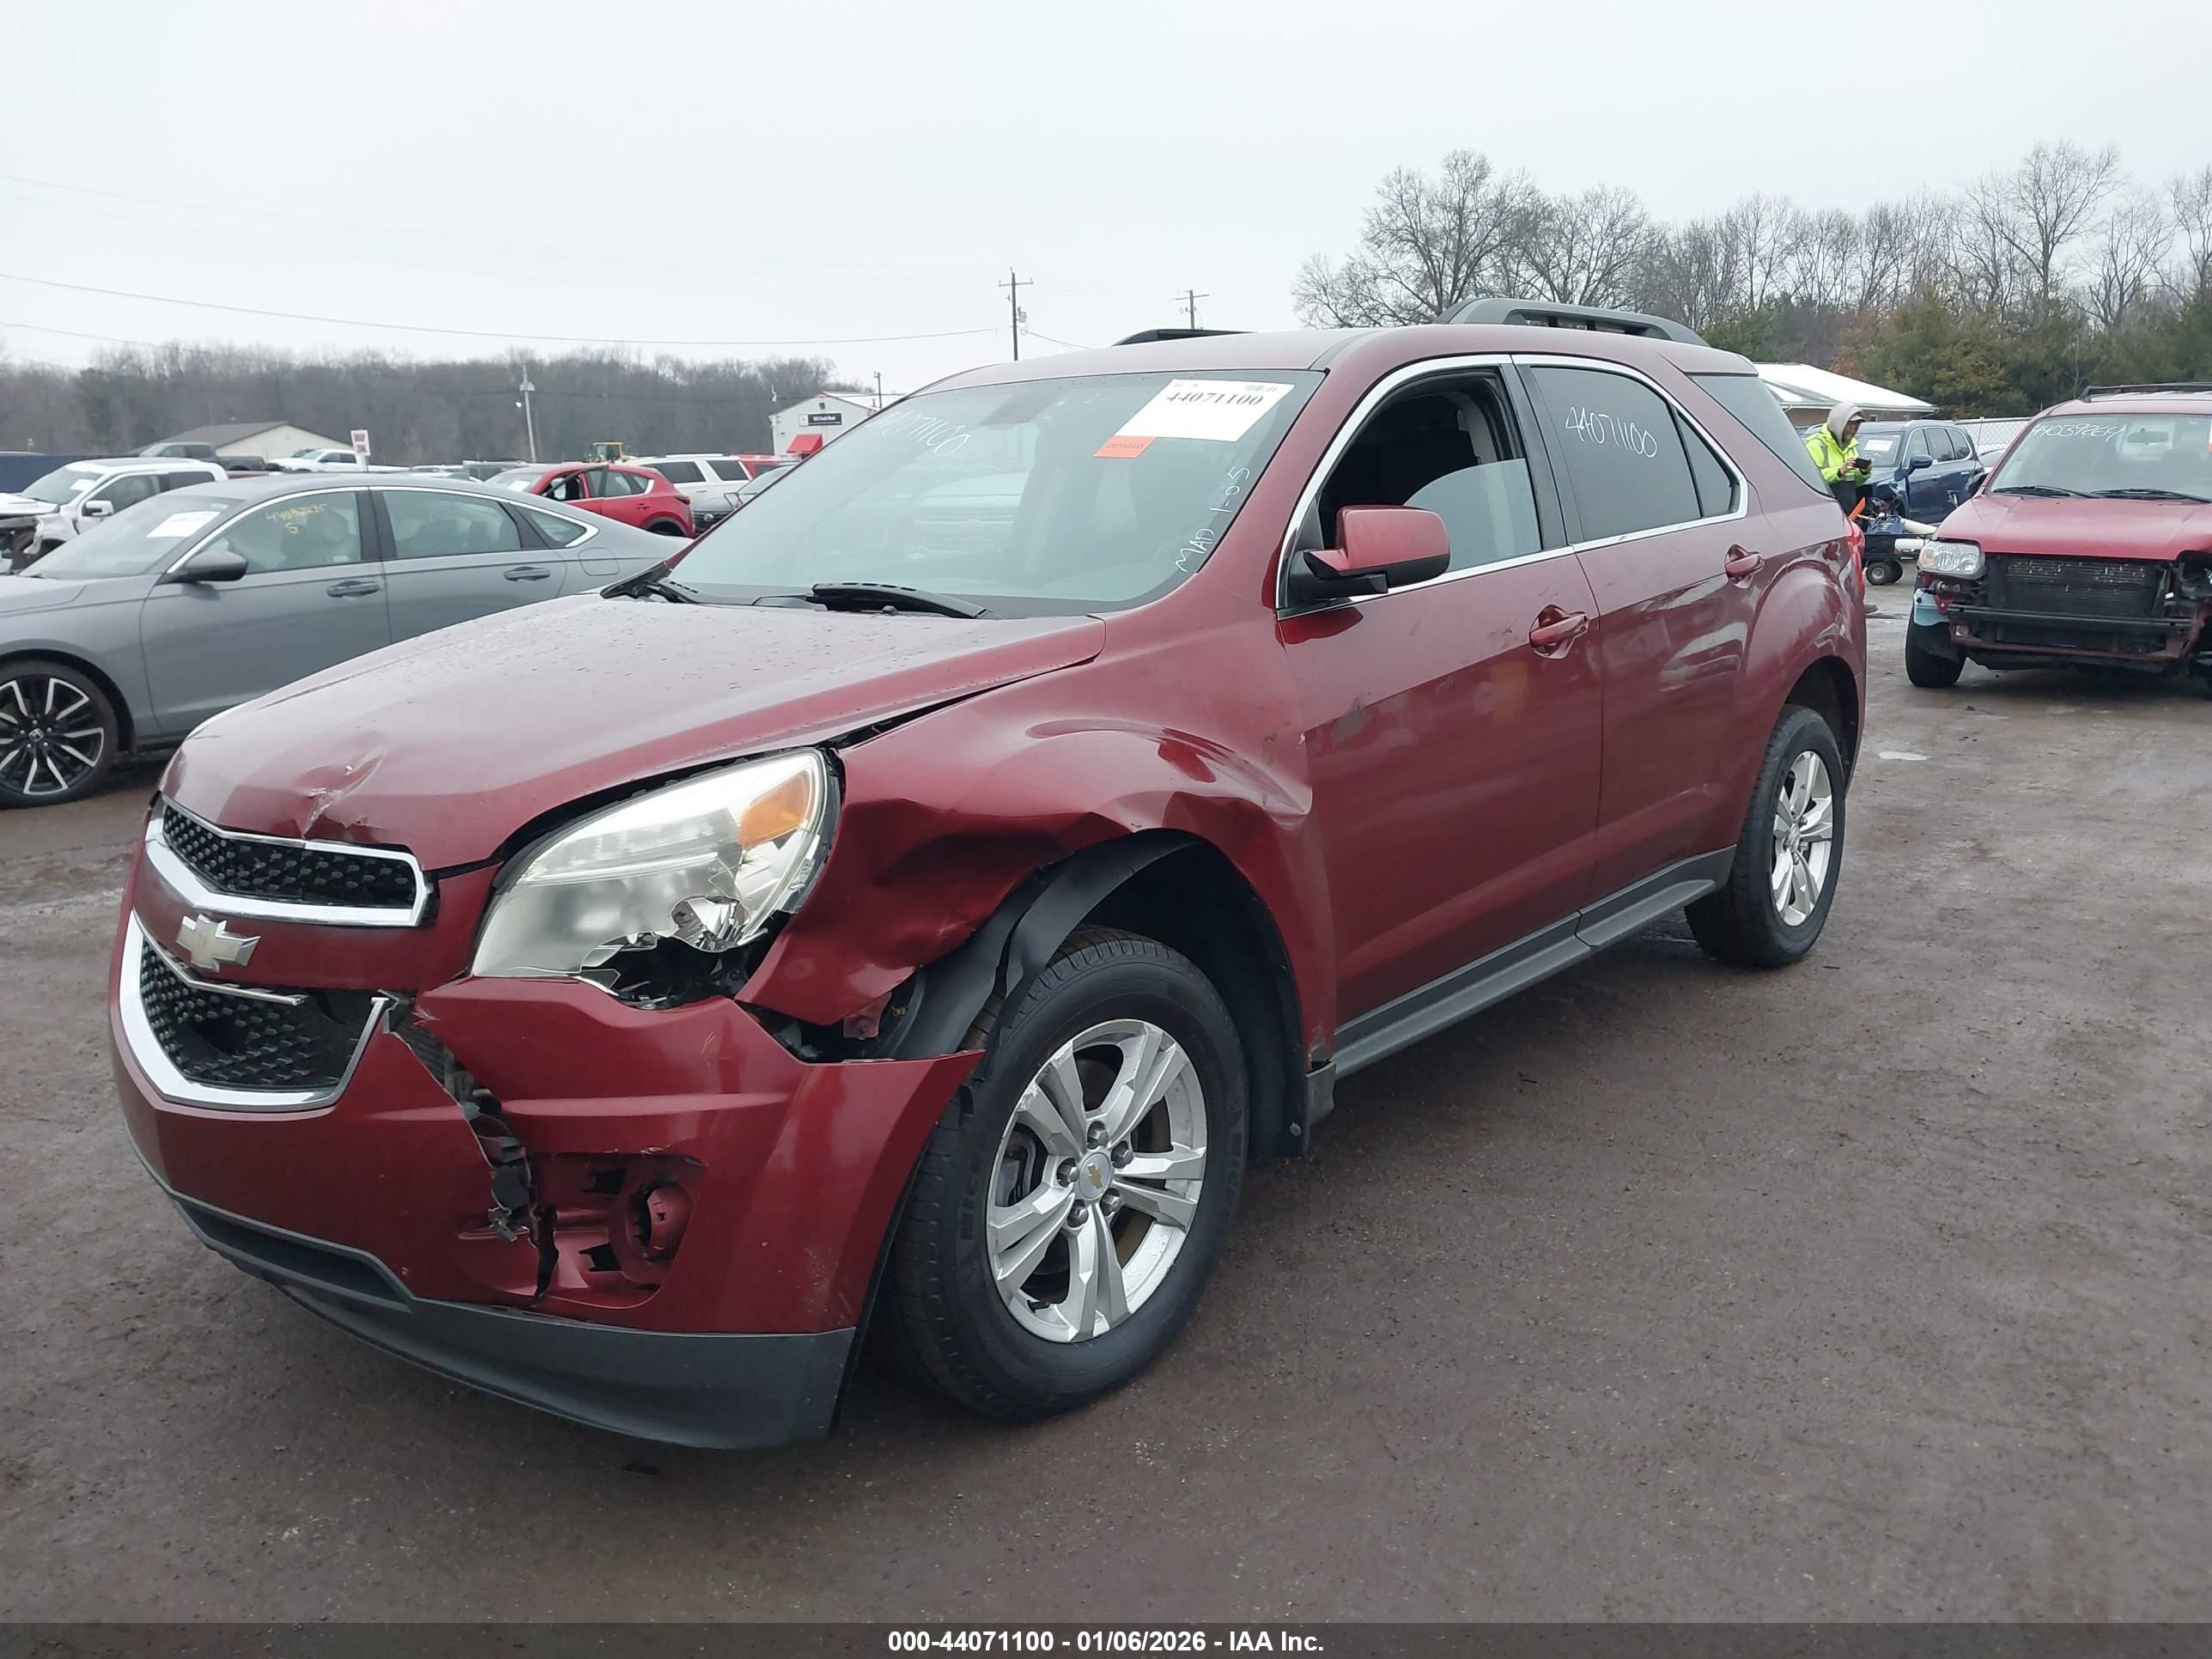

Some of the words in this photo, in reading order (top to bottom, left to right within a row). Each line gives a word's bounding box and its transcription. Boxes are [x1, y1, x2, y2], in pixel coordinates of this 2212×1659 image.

[1166, 391, 1264, 406] 44071100
[1566, 405, 1657, 458] 44071100
[1175, 528, 1215, 573] MAD
[1209, 466, 1250, 513] 1-05
